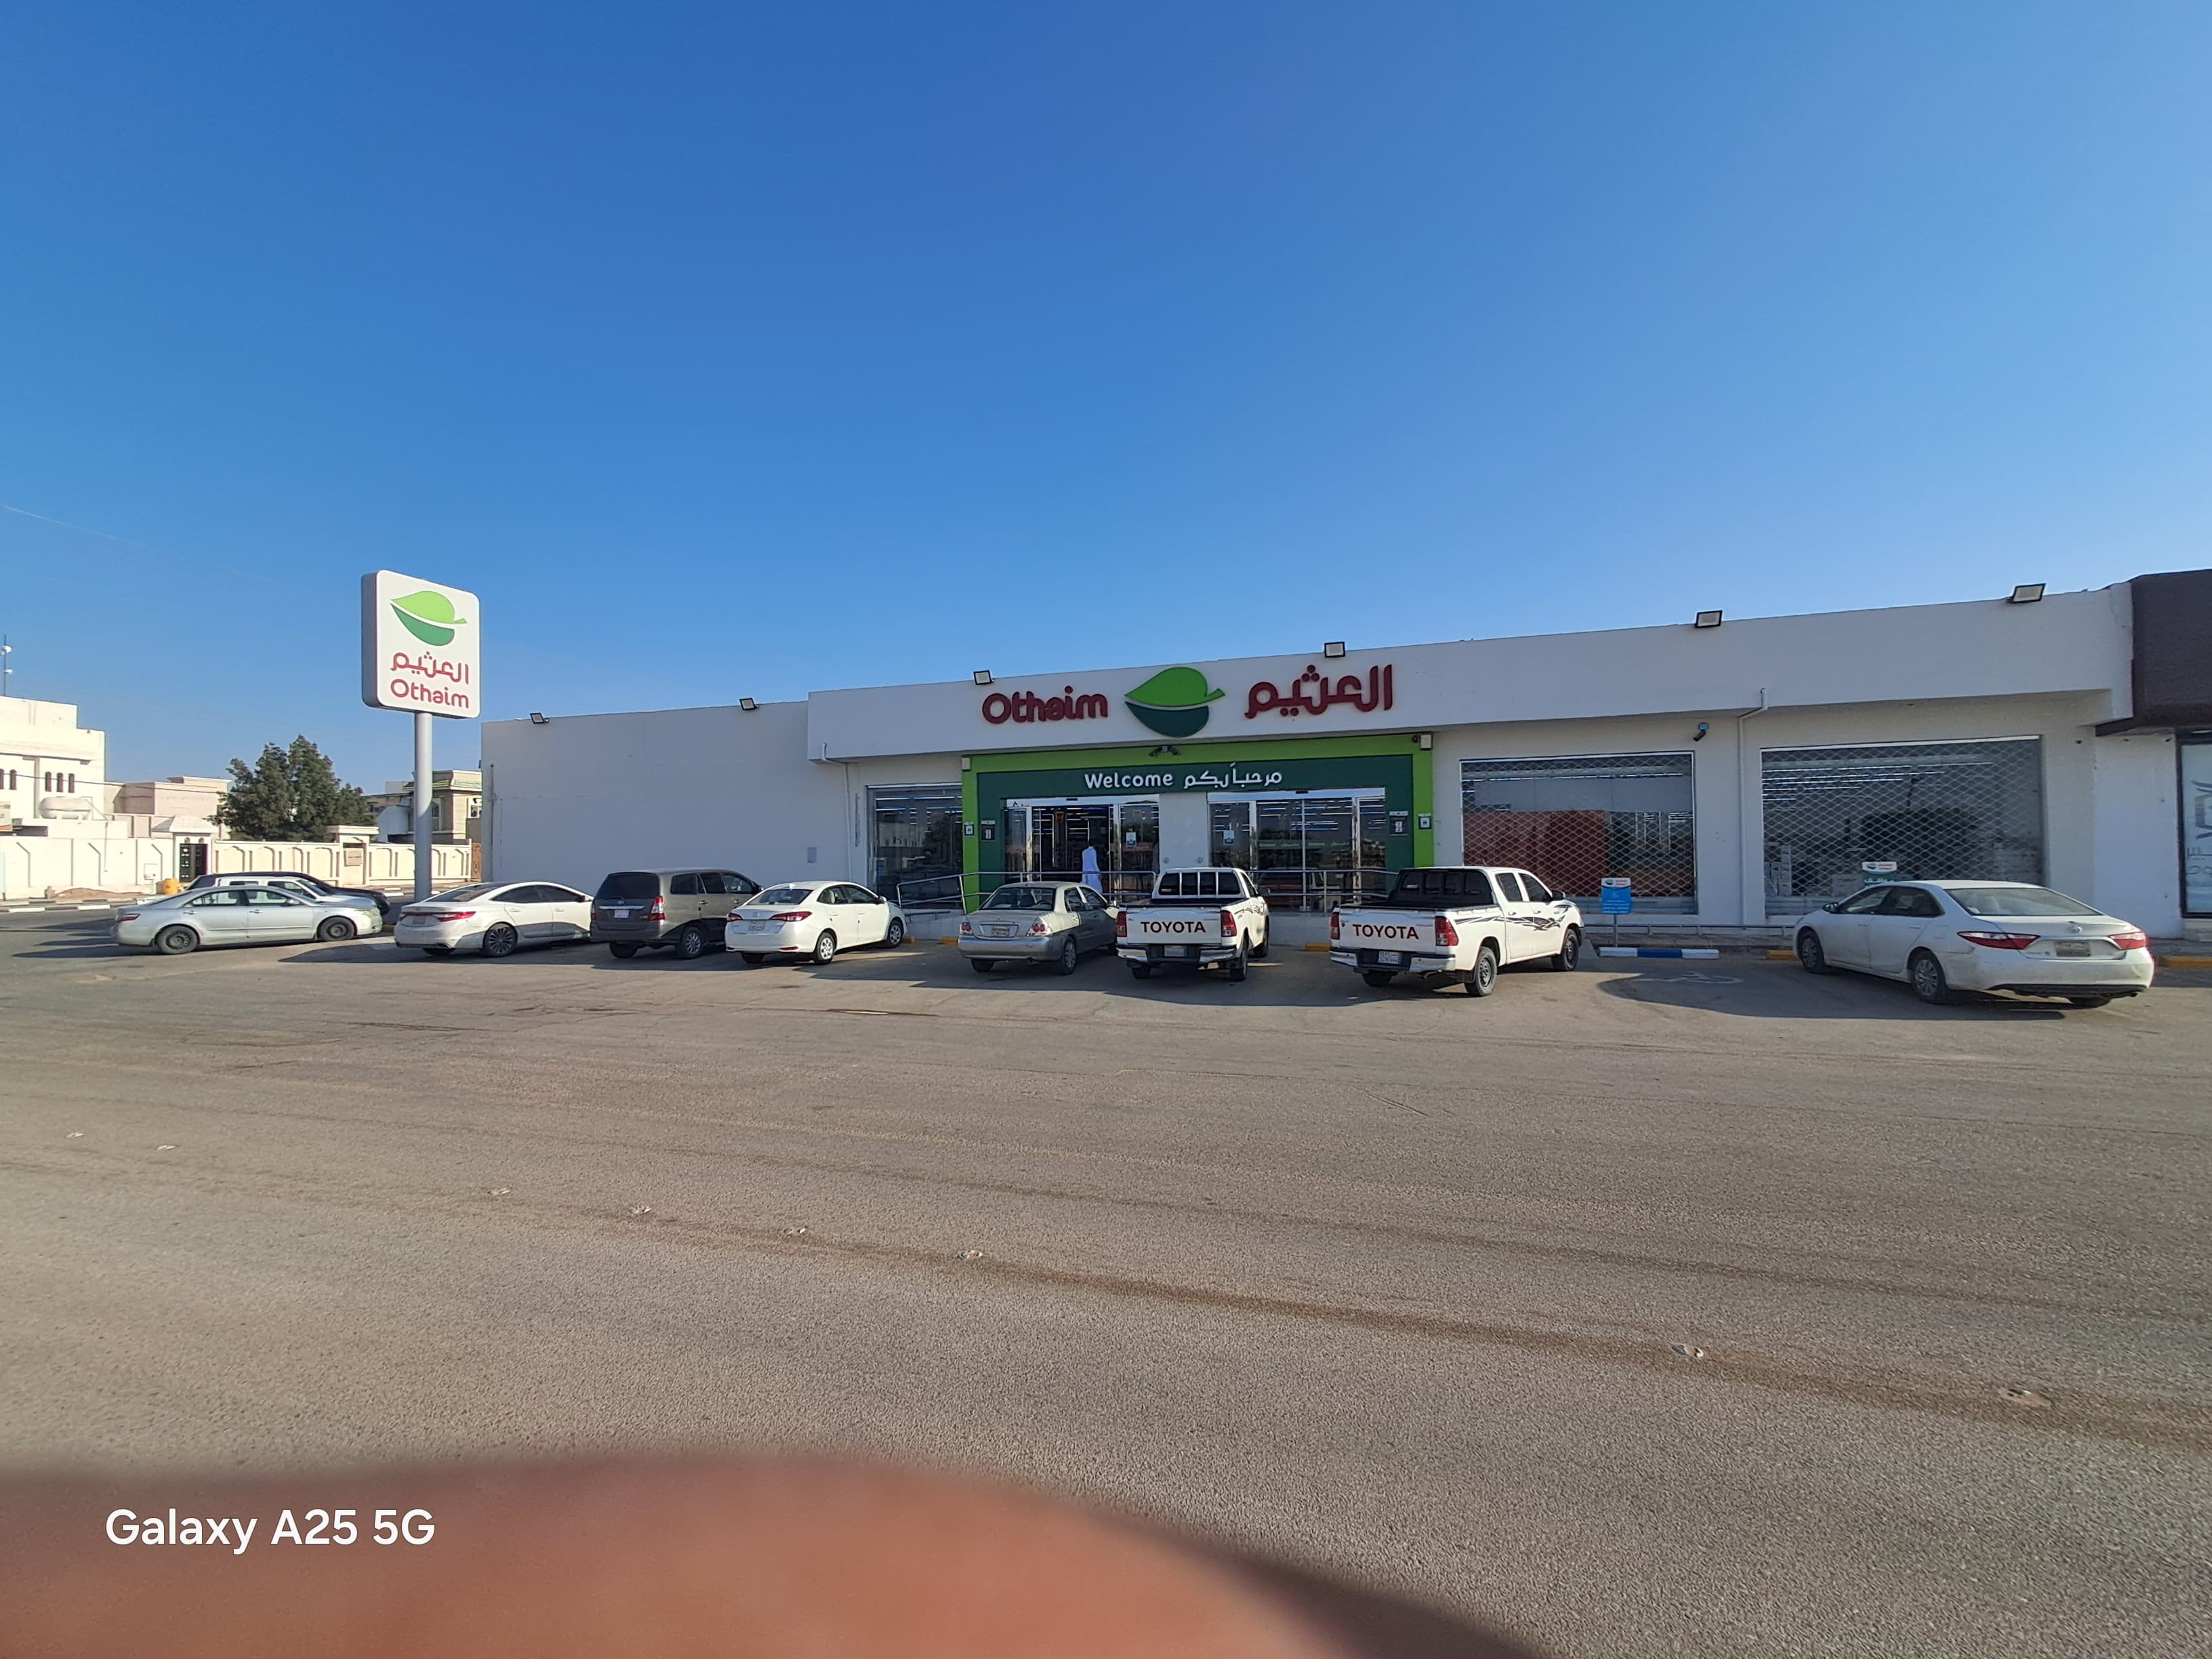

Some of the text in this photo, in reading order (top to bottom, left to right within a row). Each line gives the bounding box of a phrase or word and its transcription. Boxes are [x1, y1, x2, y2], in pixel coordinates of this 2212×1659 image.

[390, 651, 470, 685] العثيم
[390, 678, 470, 709] Othaim
[981, 685, 1109, 724] Othaim
[1244, 664, 1393, 720] العثيم
[1084, 772, 1173, 790] Welcome
[1183, 770, 1229, 790] بكم
[1140, 921, 1206, 934] TOYOTA
[1352, 924, 1420, 940] TOYOTA
